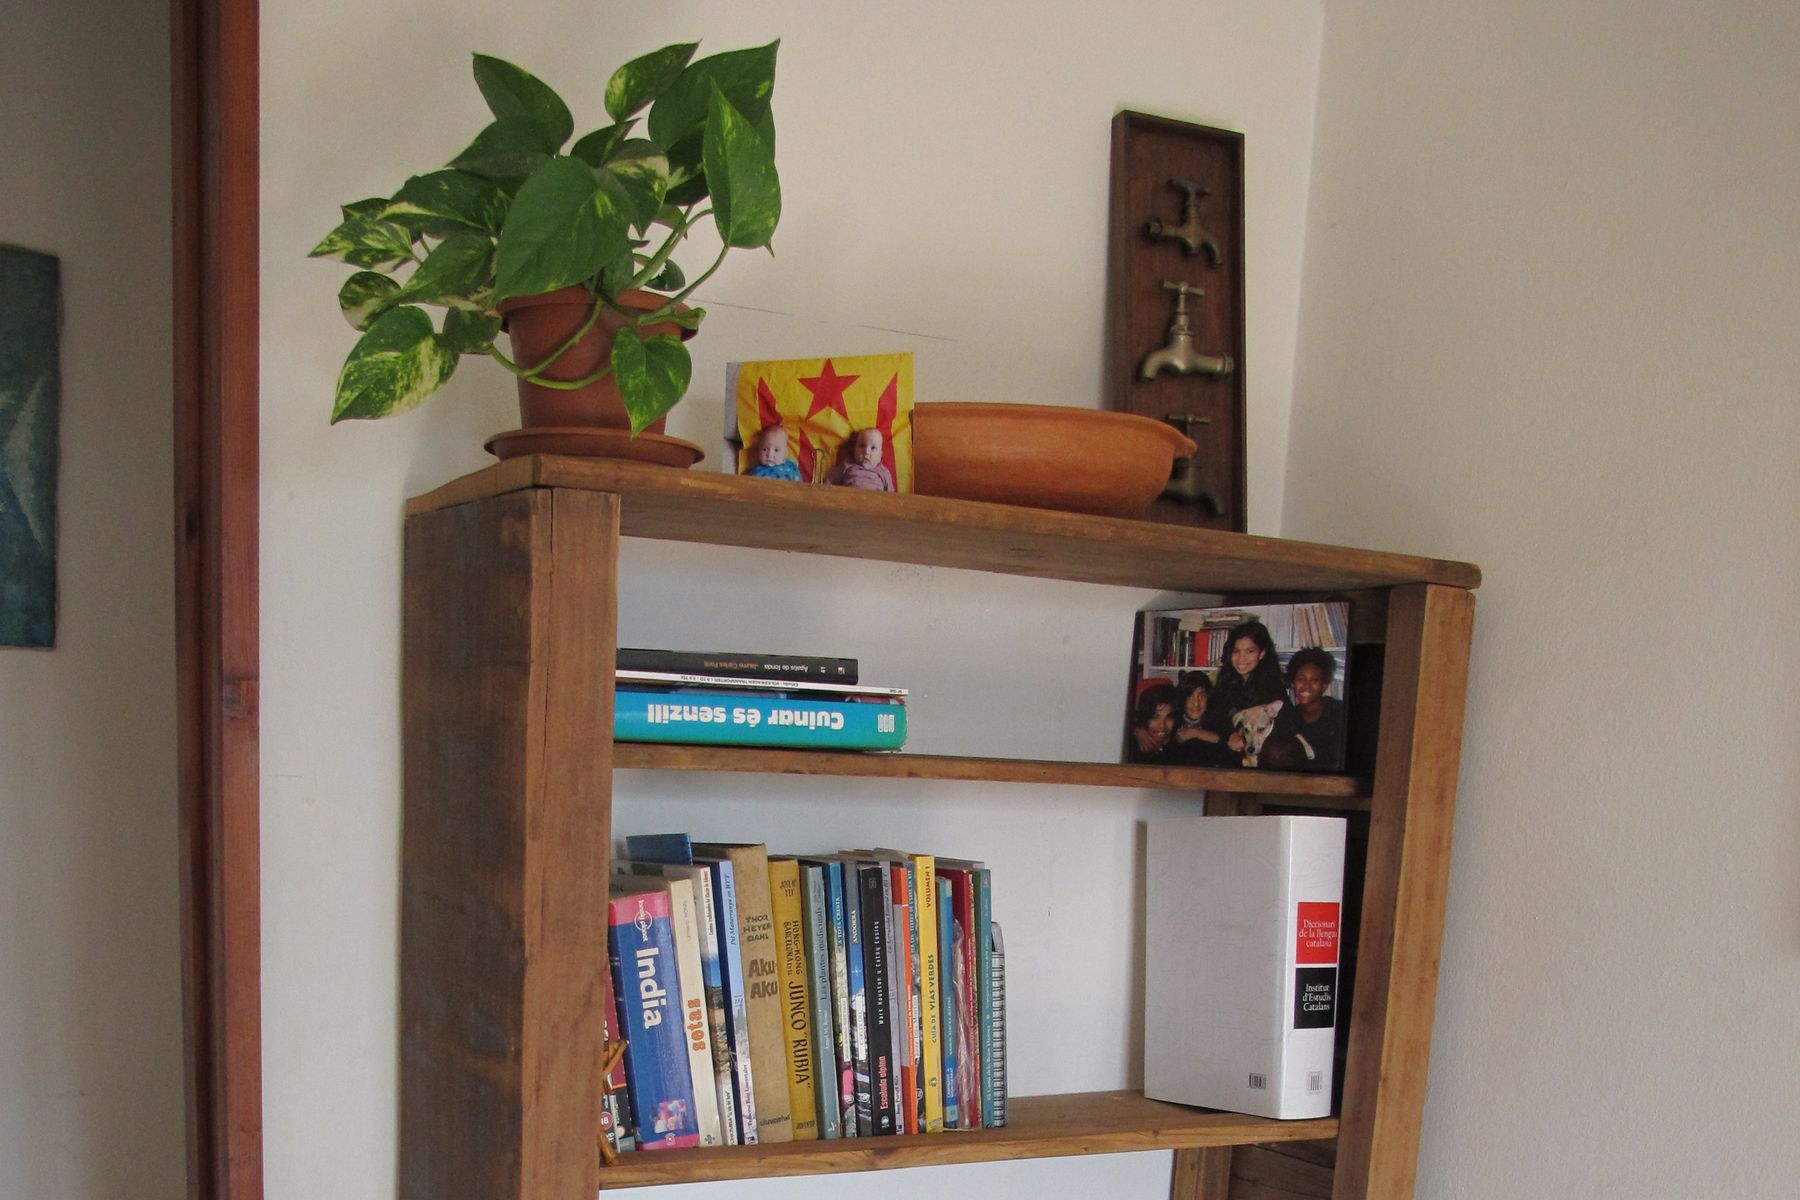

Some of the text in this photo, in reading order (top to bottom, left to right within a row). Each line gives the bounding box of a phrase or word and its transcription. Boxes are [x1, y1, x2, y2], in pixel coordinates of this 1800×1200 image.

[648, 703, 845, 730] Cuinar és senzill
[745, 914, 768, 923] THOR
[815, 907, 825, 952] medicinals
[850, 910, 859, 943] ANDORRA
[1303, 919, 1336, 928] Diccionari
[638, 920, 650, 943] planet
[746, 933, 769, 942] DAHL
[784, 921, 794, 962] BARCELONA
[1298, 928, 1338, 940] de la llengua
[1306, 938, 1333, 948] catalana
[792, 920, 803, 975] HONG-KONG
[817, 953, 828, 983] plantes
[927, 954, 935, 988] VERDES
[636, 947, 667, 1029] India
[928, 990, 936, 1010] VÍAS
[1302, 992, 1331, 1002] d'Estudis
[1305, 983, 1330, 992] Institut
[788, 981, 807, 1030] JUNCO
[1303, 1002, 1331, 1012] Catalans
[877, 1056, 889, 1110] Escalada alpina
